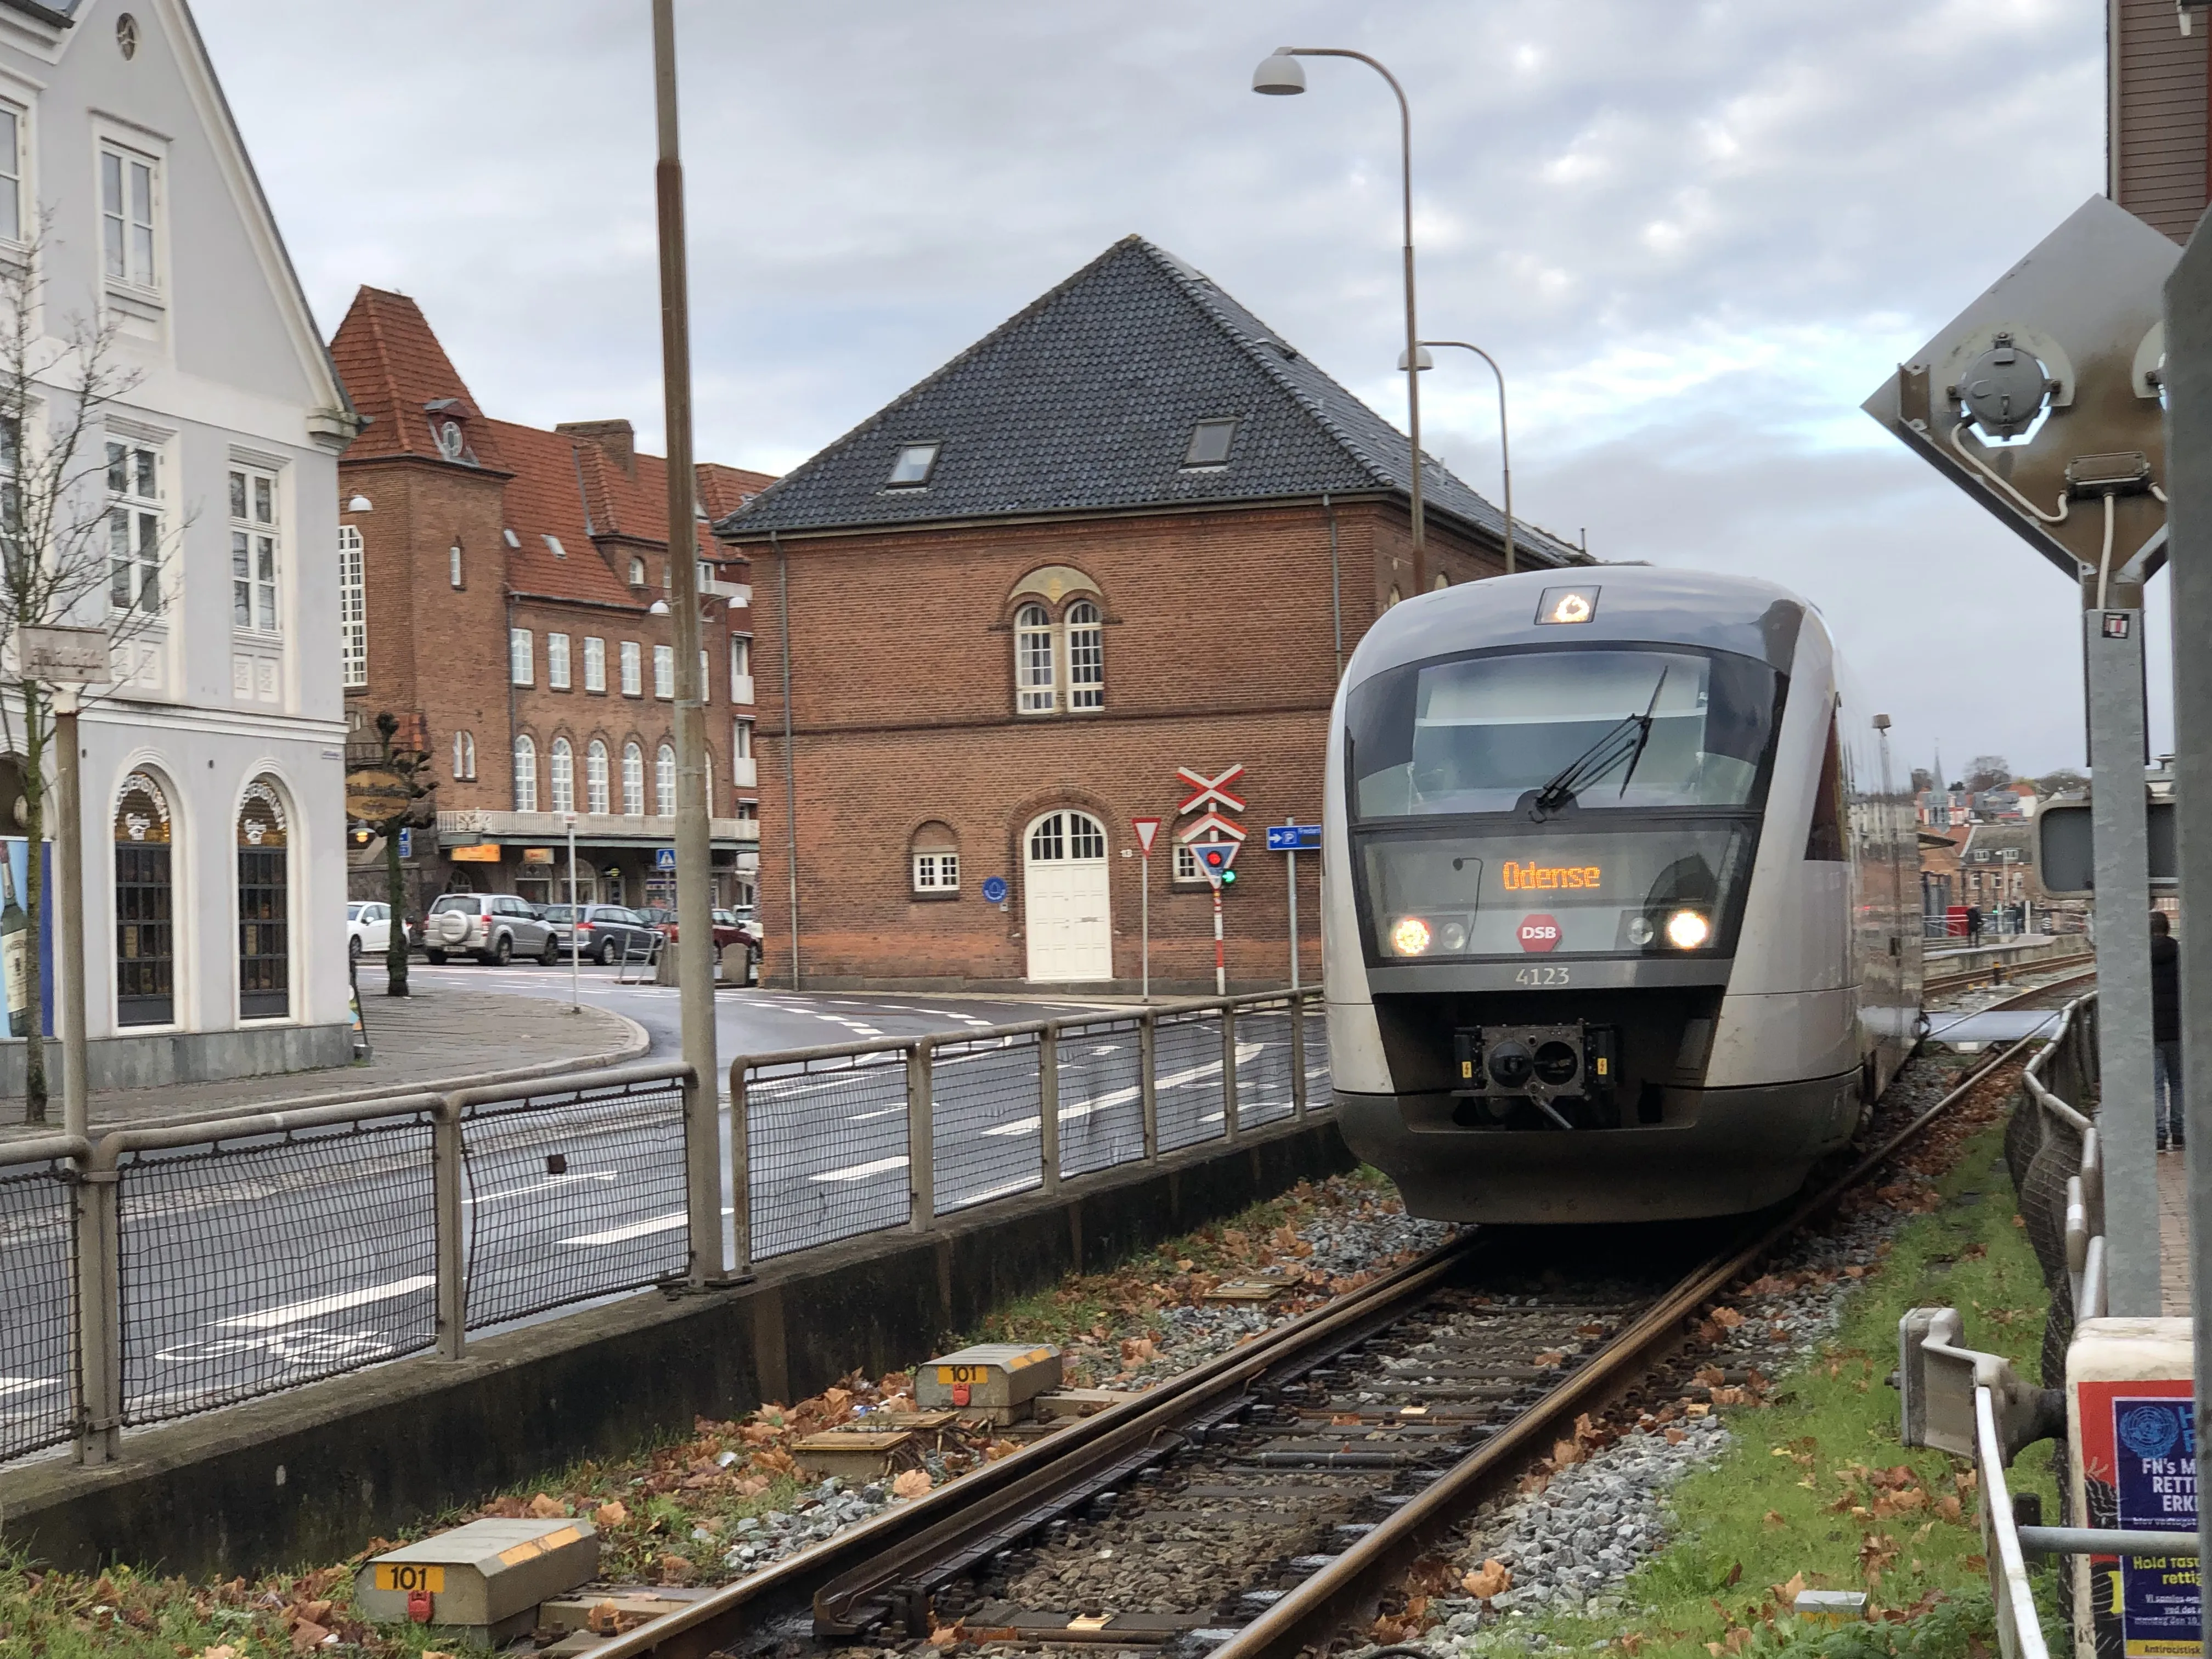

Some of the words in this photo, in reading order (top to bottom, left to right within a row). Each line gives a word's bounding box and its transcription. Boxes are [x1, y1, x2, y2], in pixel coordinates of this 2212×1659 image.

[1503, 860, 1600, 890] Odense
[1521, 926, 1556, 939] DSB
[1515, 967, 1570, 985] 4123
[950, 1365, 976, 1382] 101
[2142, 1458, 2176, 1475] FN's
[2133, 1556, 2166, 1570] Hold
[391, 1565, 427, 1590] 101
